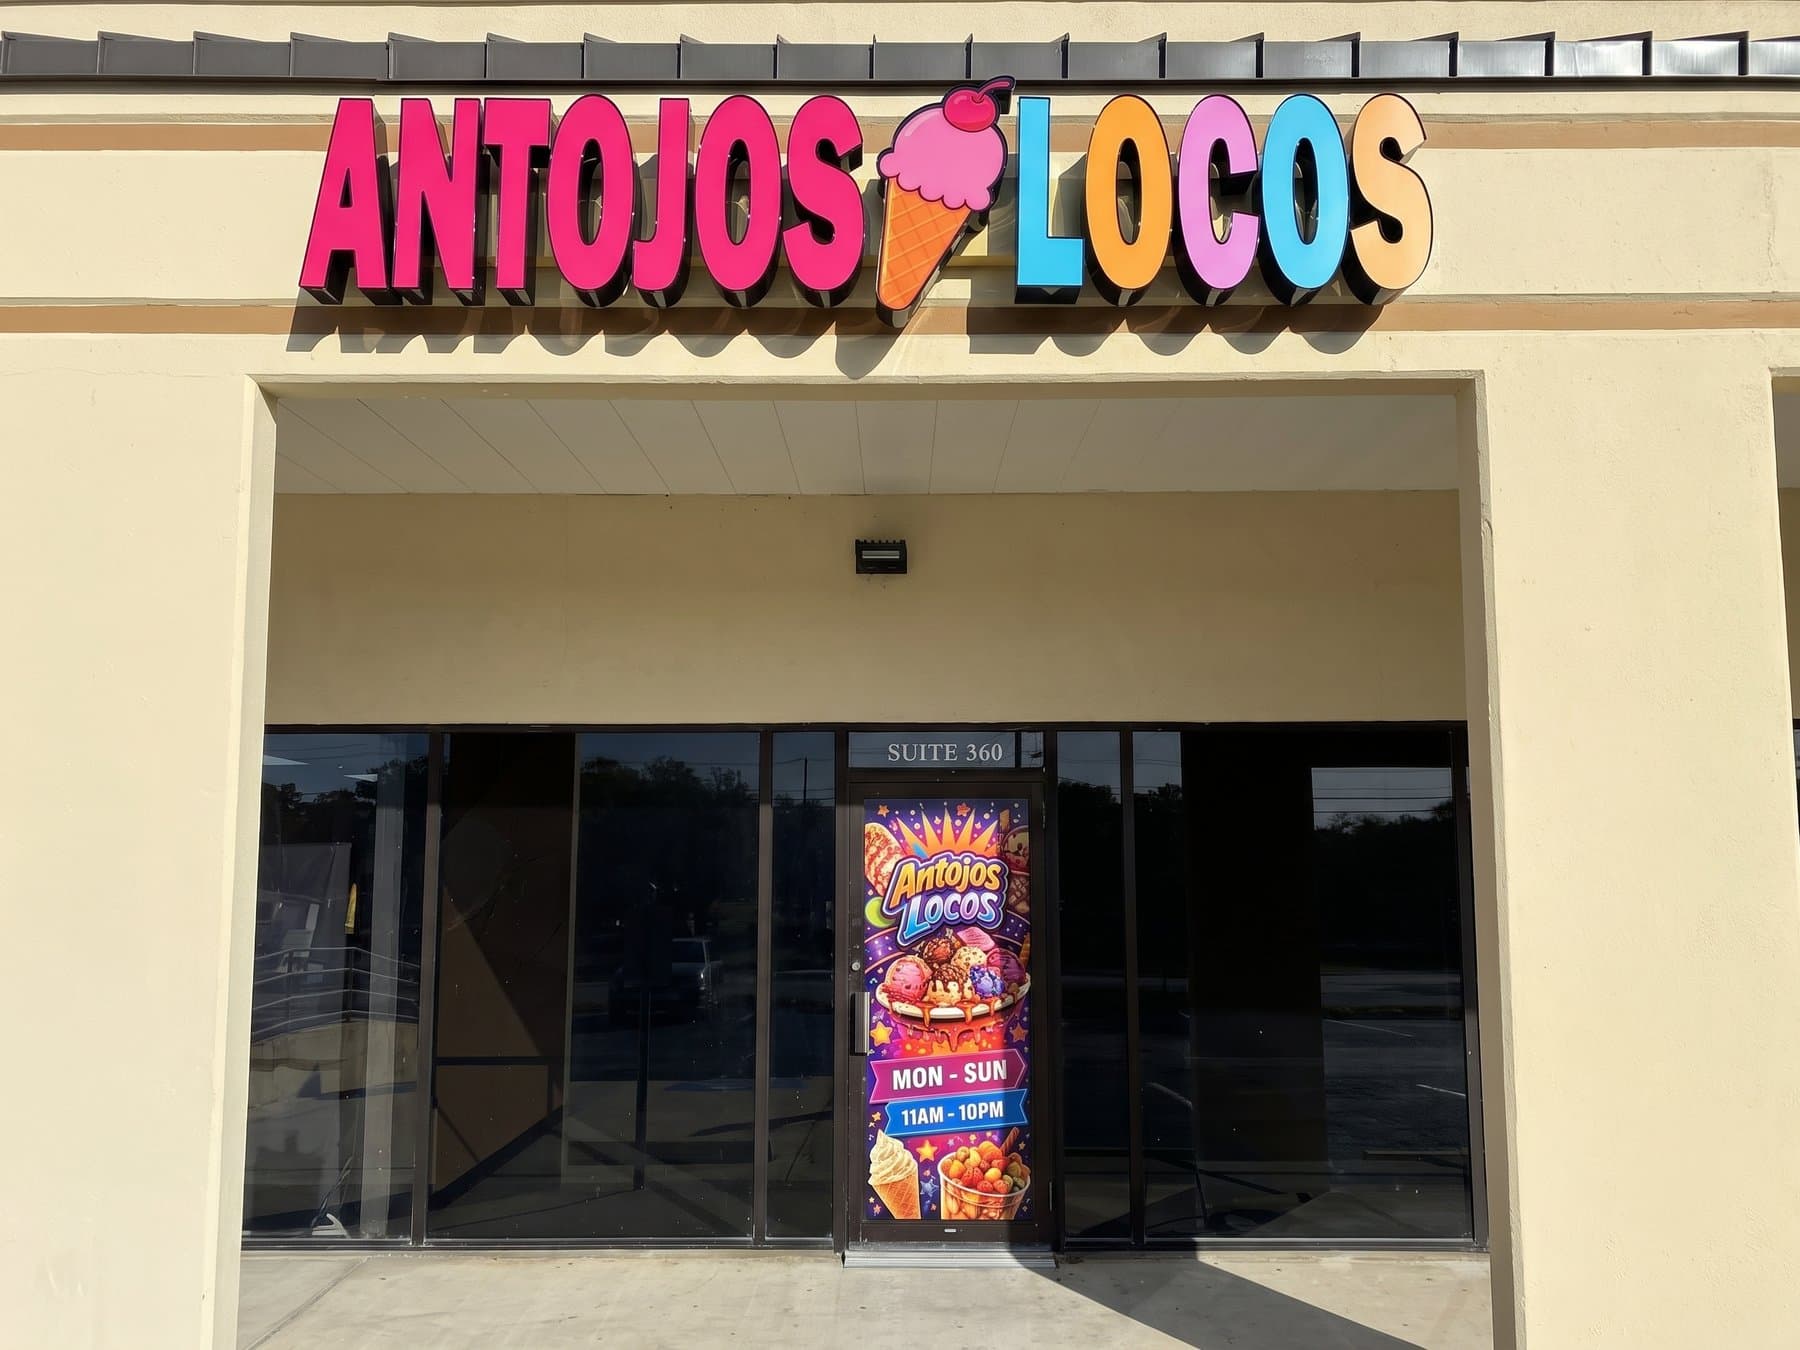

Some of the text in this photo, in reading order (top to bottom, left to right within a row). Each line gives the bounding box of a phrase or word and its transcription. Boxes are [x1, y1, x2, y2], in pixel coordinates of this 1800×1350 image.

[299, 93, 1434, 292] ANTOJOS LOCOS
[888, 743, 1003, 761] SUITE 360
[889, 858, 1001, 909] Antojos
[892, 1065, 943, 1090] MON
[964, 1060, 1007, 1084] SUN
[901, 1106, 944, 1126] 11AM
[958, 1101, 1004, 1122] 10PM
